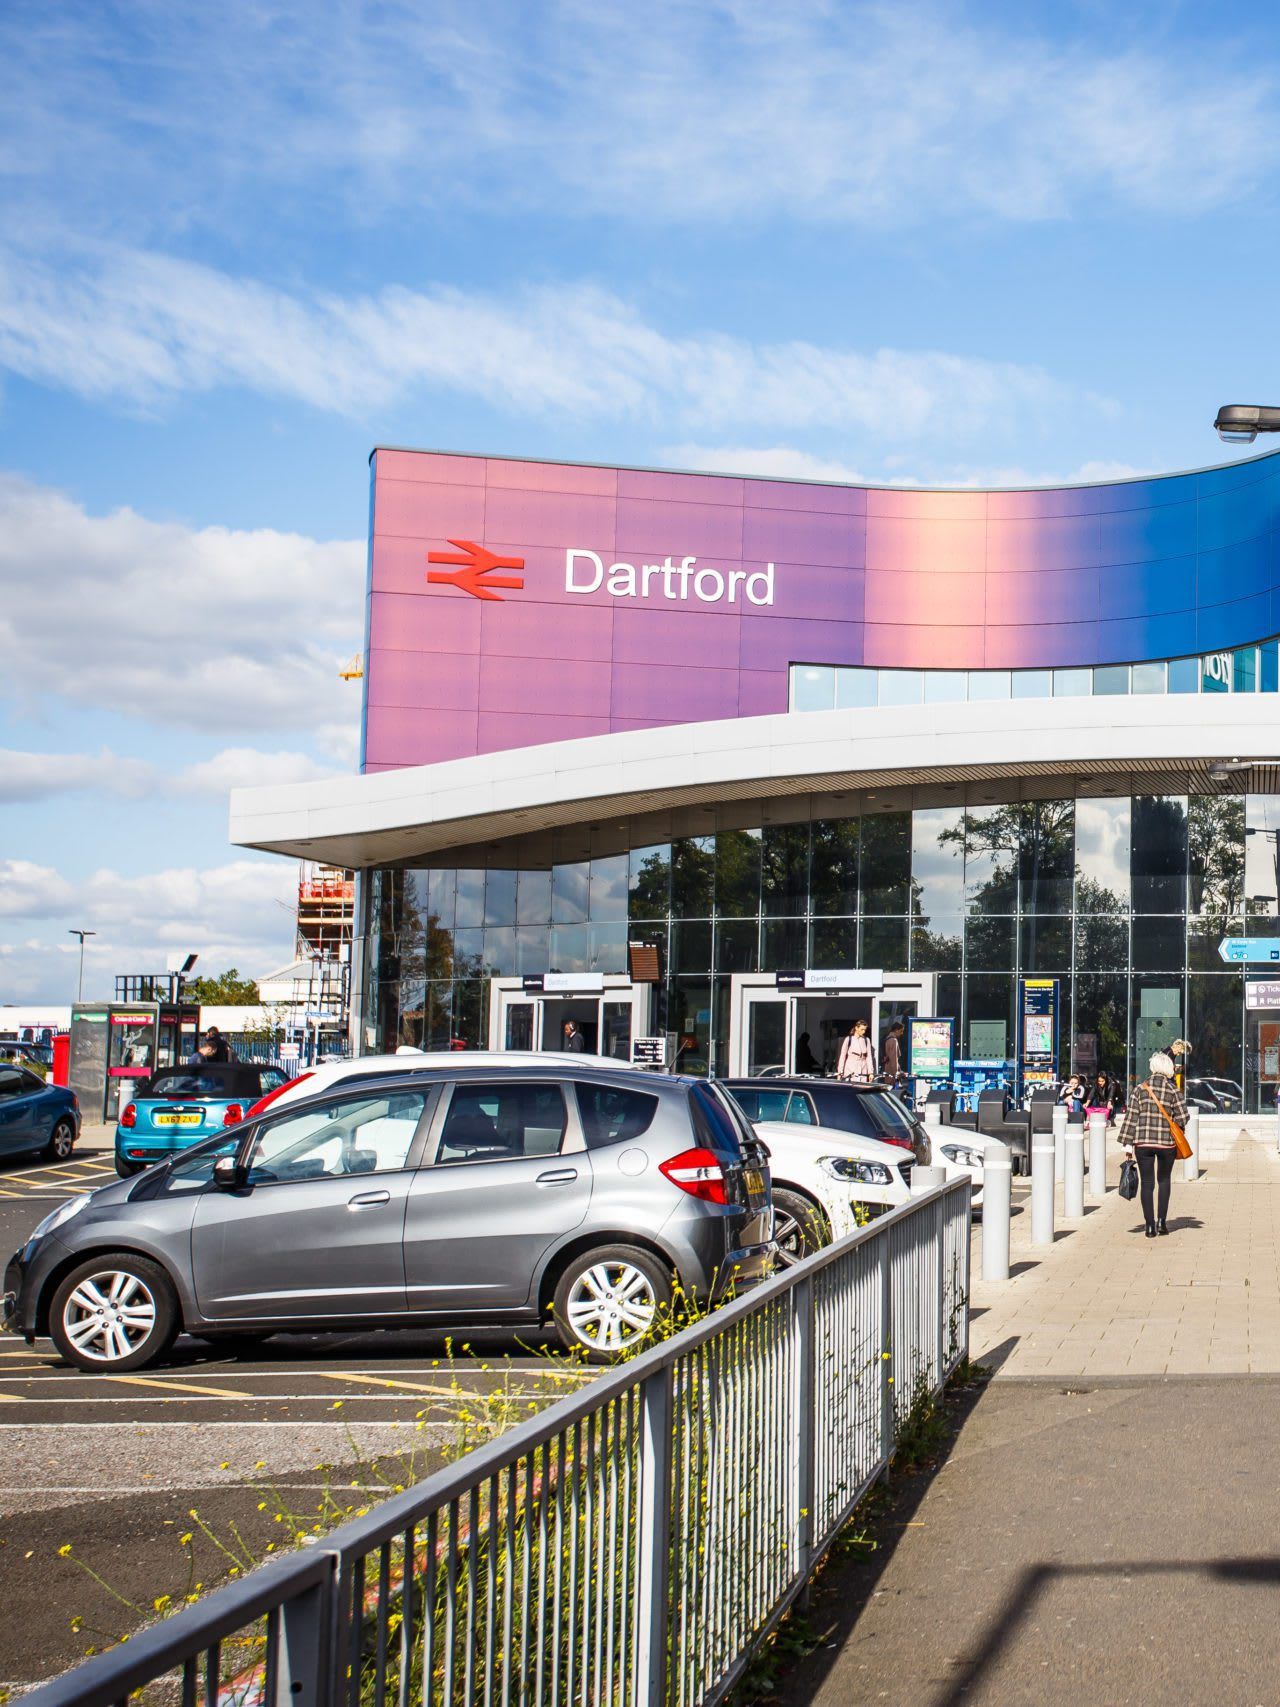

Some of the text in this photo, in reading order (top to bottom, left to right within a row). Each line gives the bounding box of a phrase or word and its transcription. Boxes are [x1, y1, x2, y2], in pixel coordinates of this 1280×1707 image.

[565, 548, 775, 606] Dartford
[810, 975, 837, 983] Dartford
[160, 1115, 181, 1123] LX67
